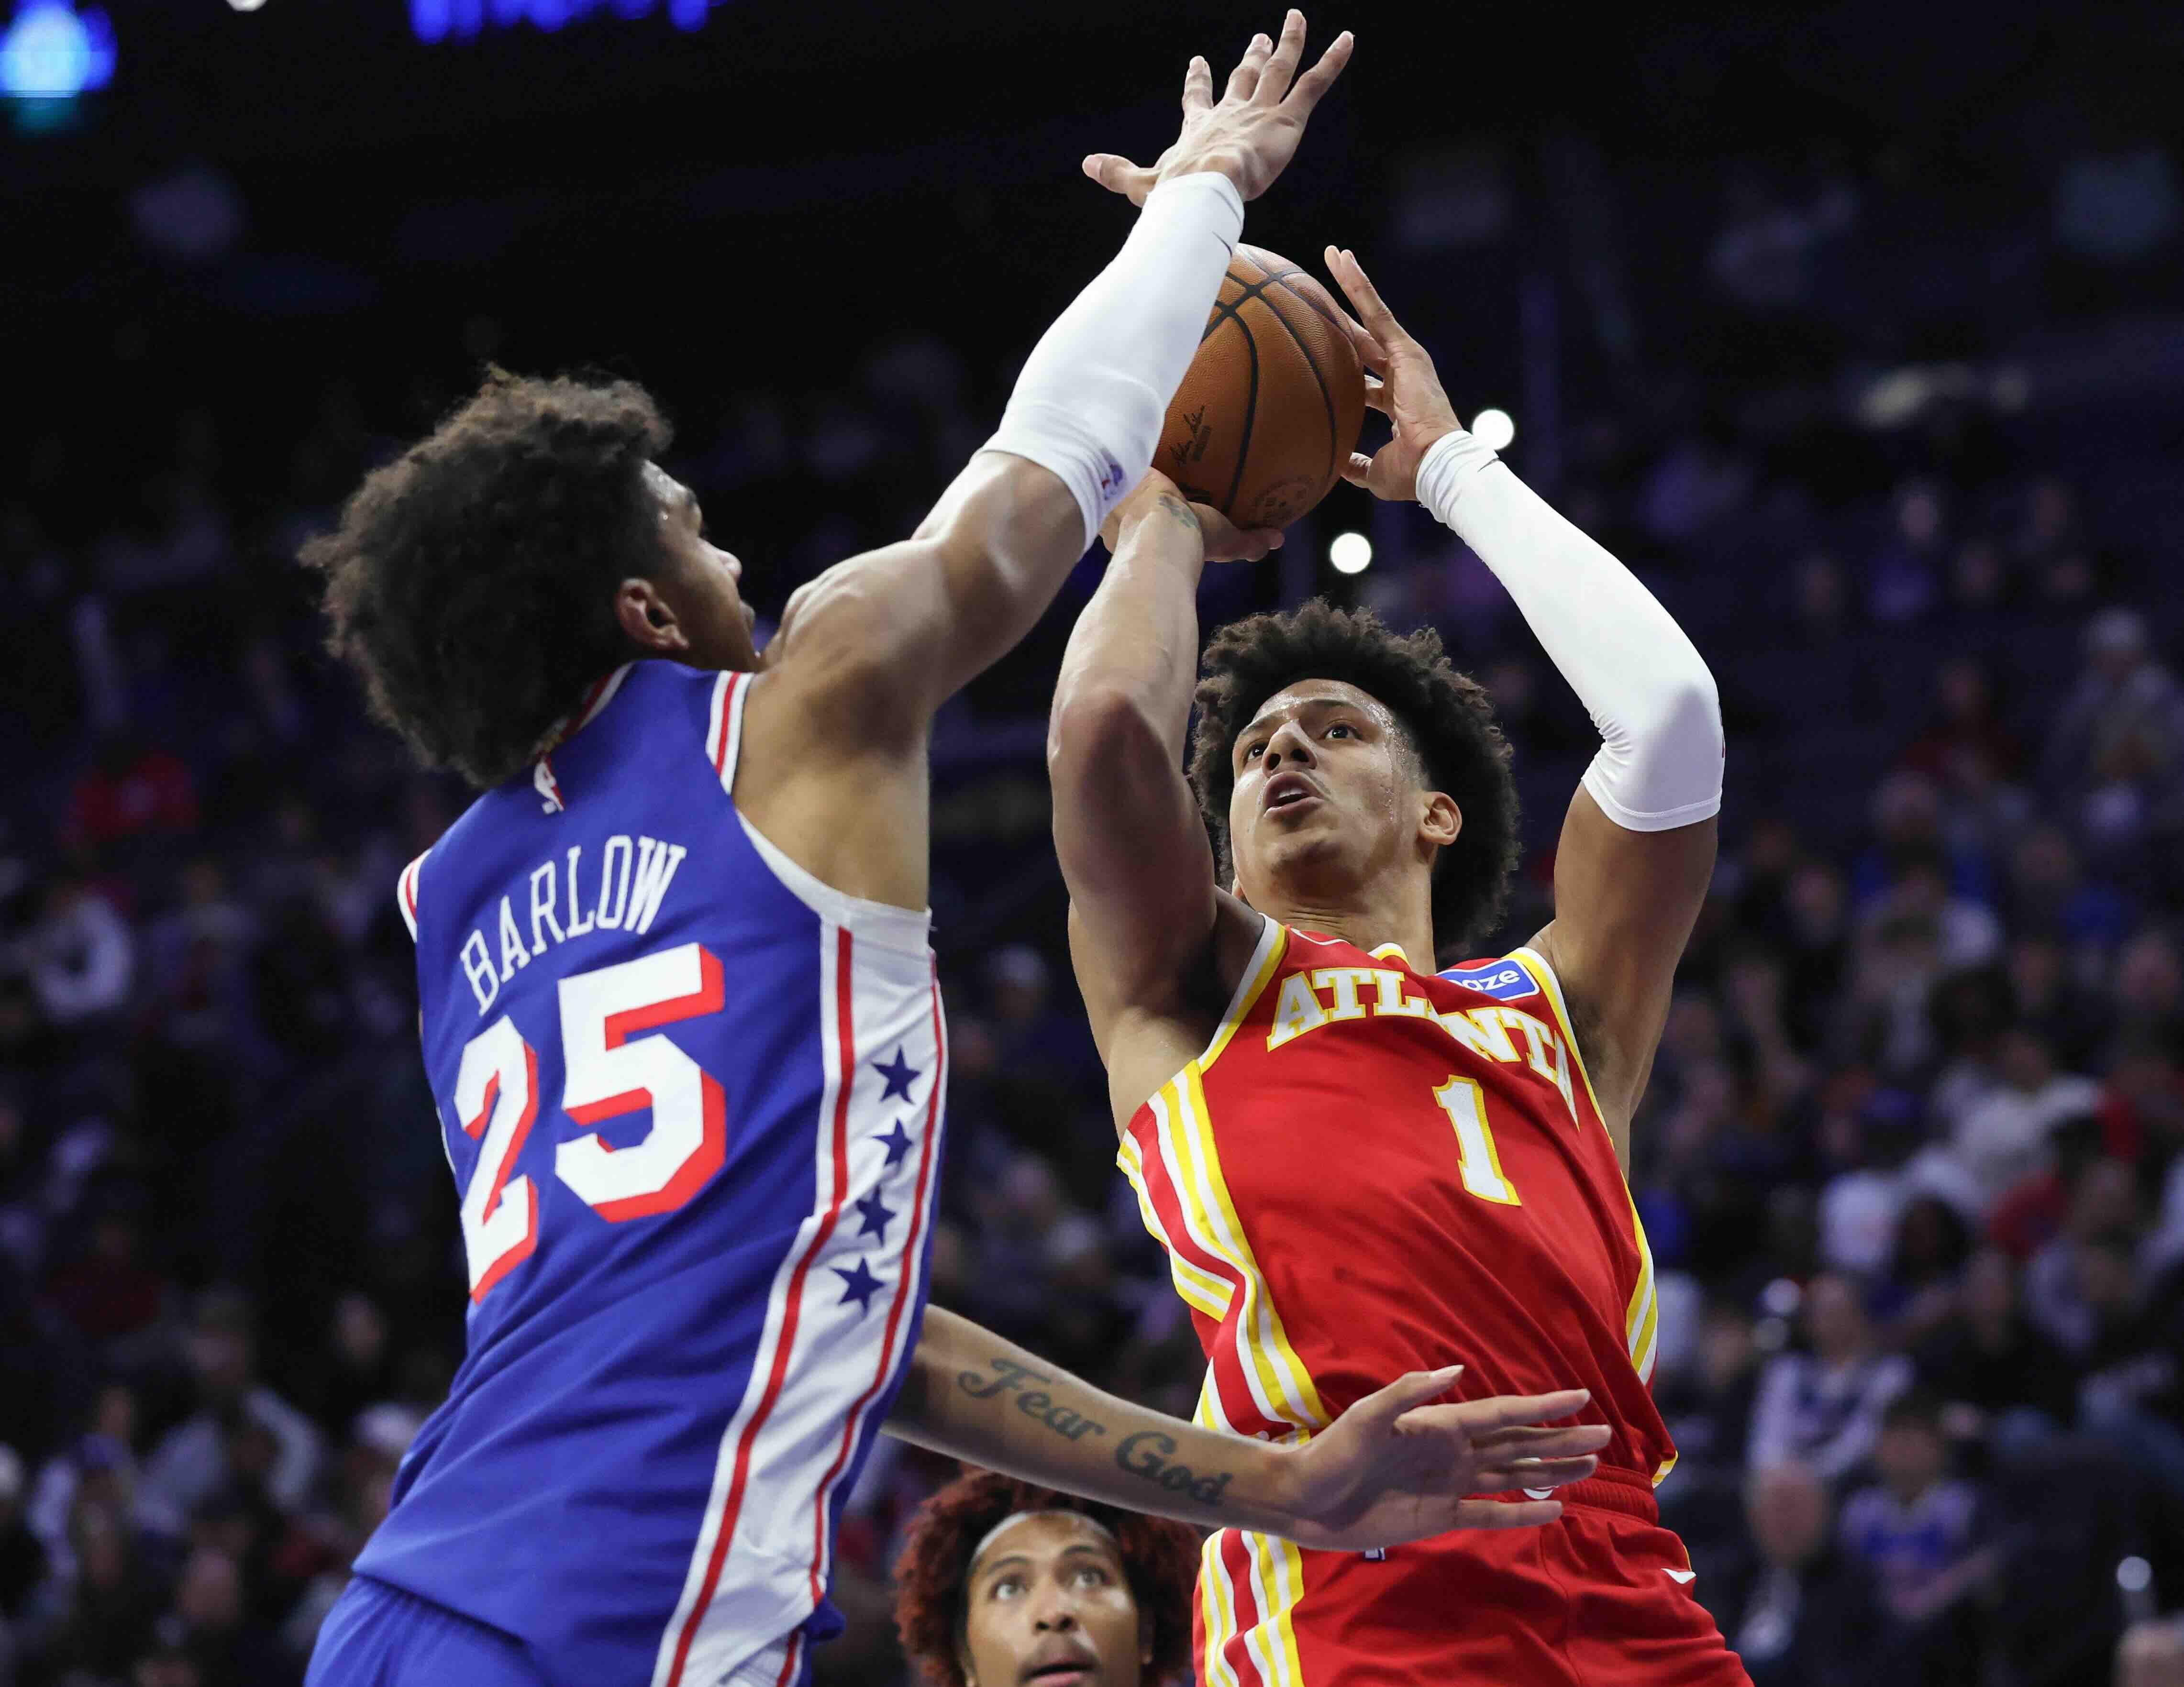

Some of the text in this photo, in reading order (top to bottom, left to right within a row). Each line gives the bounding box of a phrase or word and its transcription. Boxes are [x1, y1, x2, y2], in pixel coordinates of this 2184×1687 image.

[460, 835, 687, 1015] BARLOW
[1447, 970, 1520, 991] aze
[454, 942, 726, 1305] 25
[1432, 1074, 1521, 1206] 1
[958, 1357, 1232, 1507] Fear God
